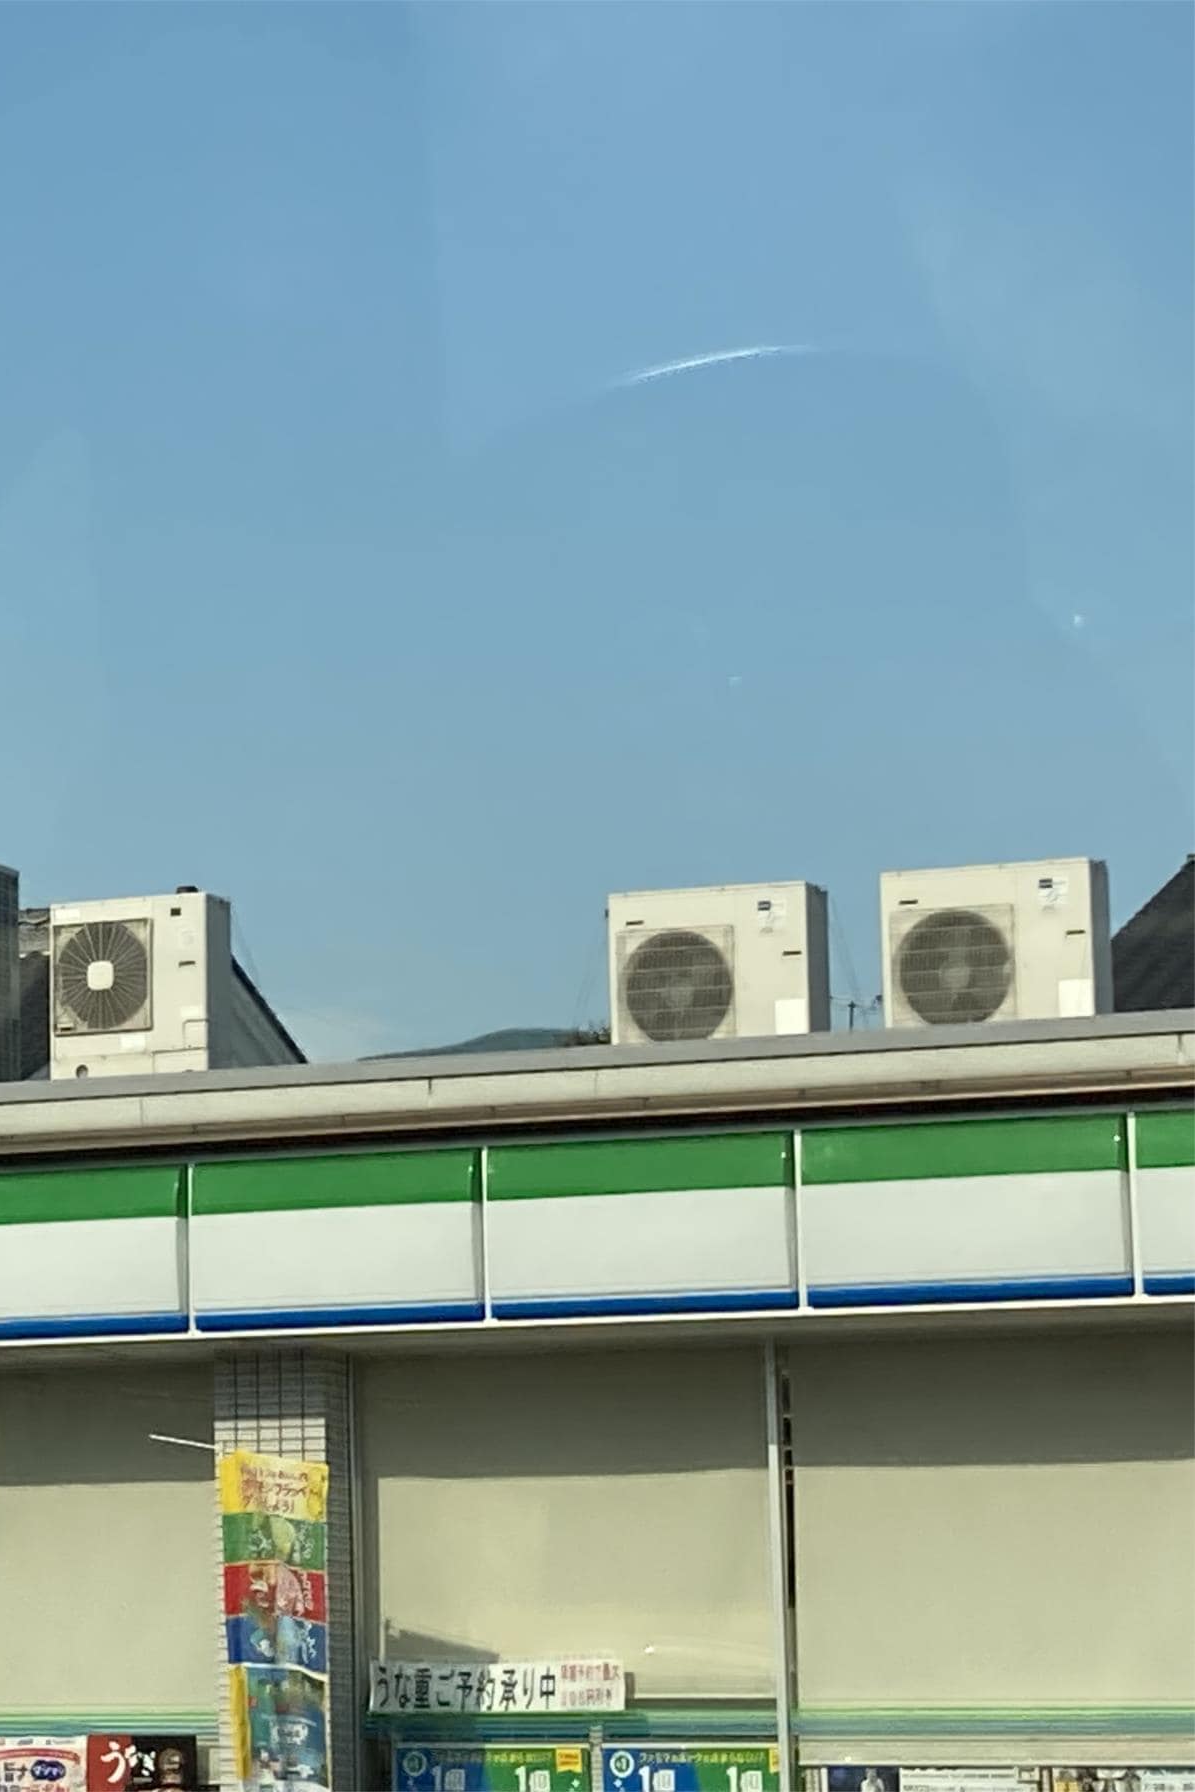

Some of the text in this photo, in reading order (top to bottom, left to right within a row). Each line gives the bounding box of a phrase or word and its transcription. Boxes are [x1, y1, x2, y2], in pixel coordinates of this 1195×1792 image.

[377, 1666, 557, 1711] うな重ご予約承り中
